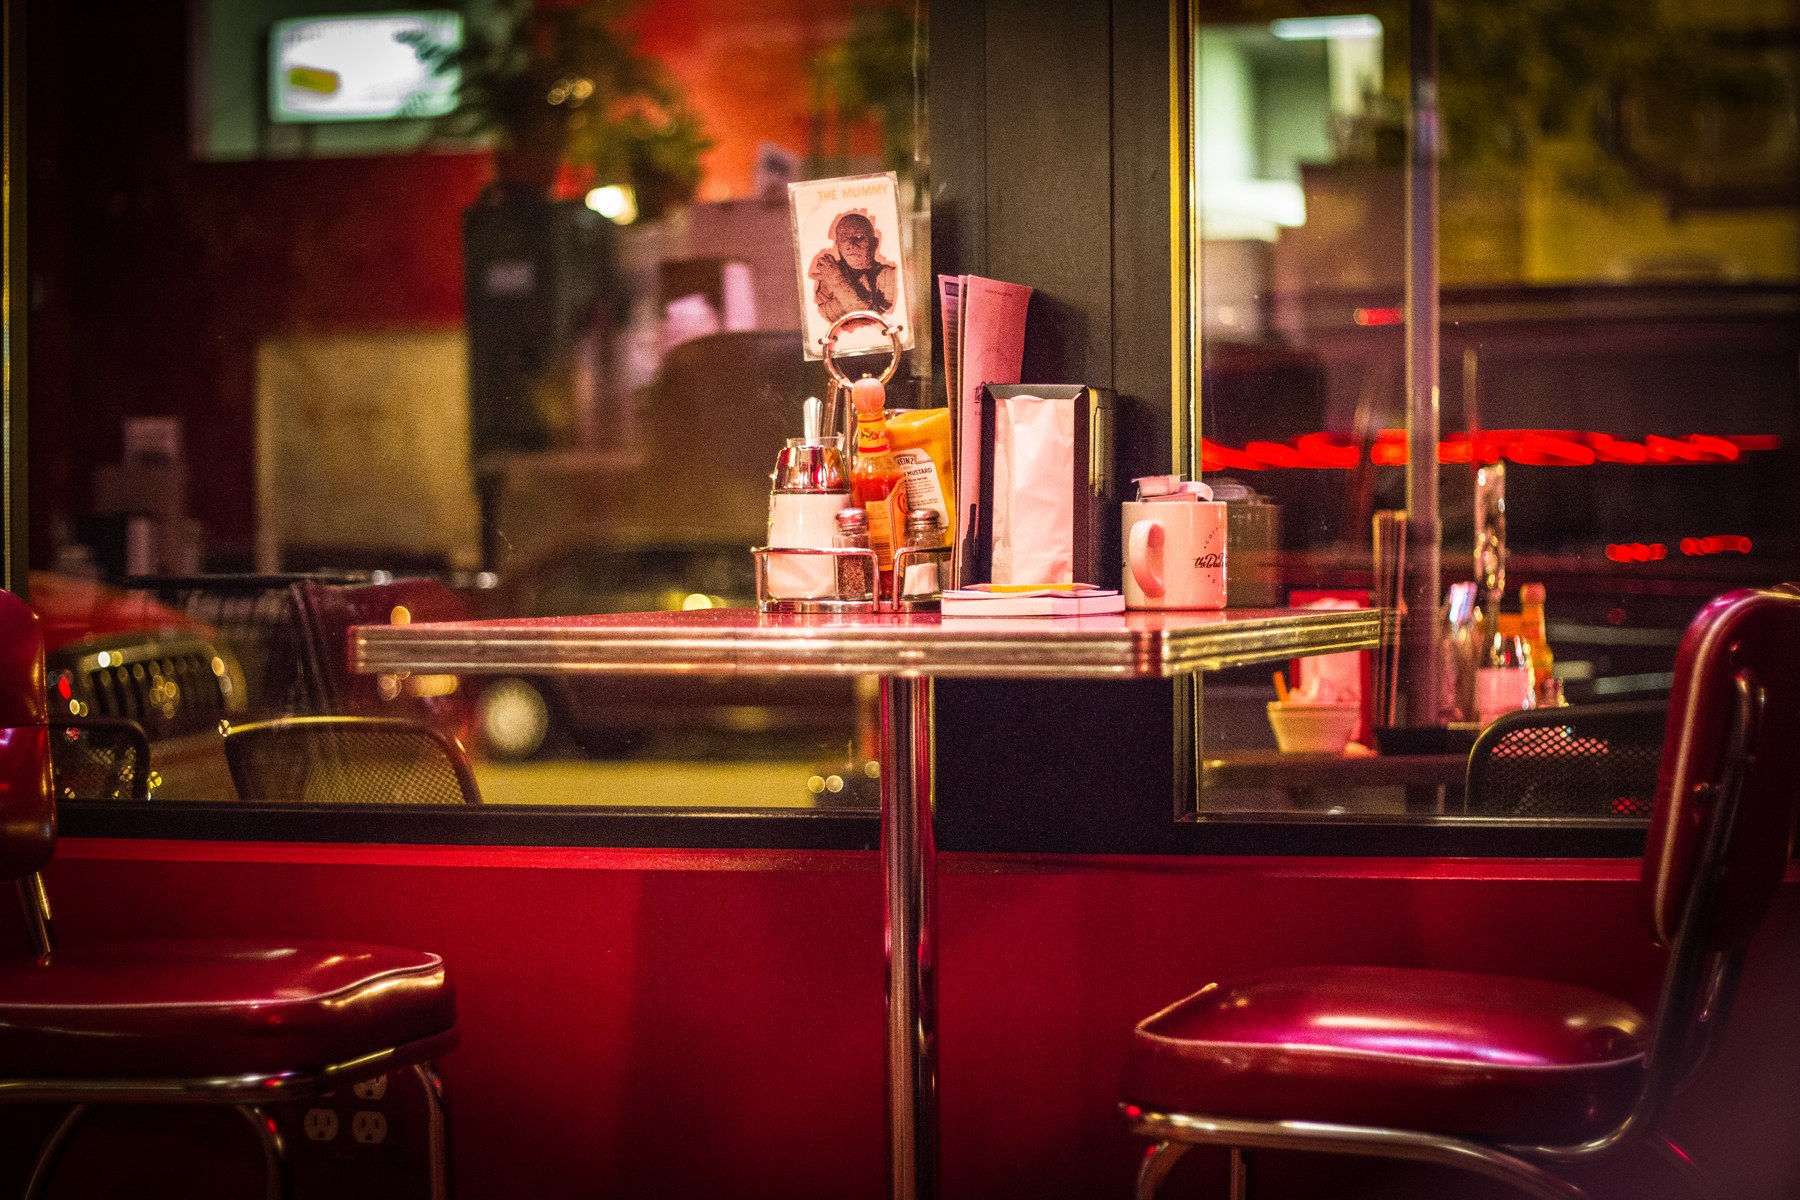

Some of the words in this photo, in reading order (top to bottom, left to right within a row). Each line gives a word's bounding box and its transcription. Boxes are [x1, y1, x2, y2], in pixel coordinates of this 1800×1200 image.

[817, 189, 837, 200] THE
[842, 184, 888, 198] MUMMY
[907, 467, 932, 476] MUSTARD
